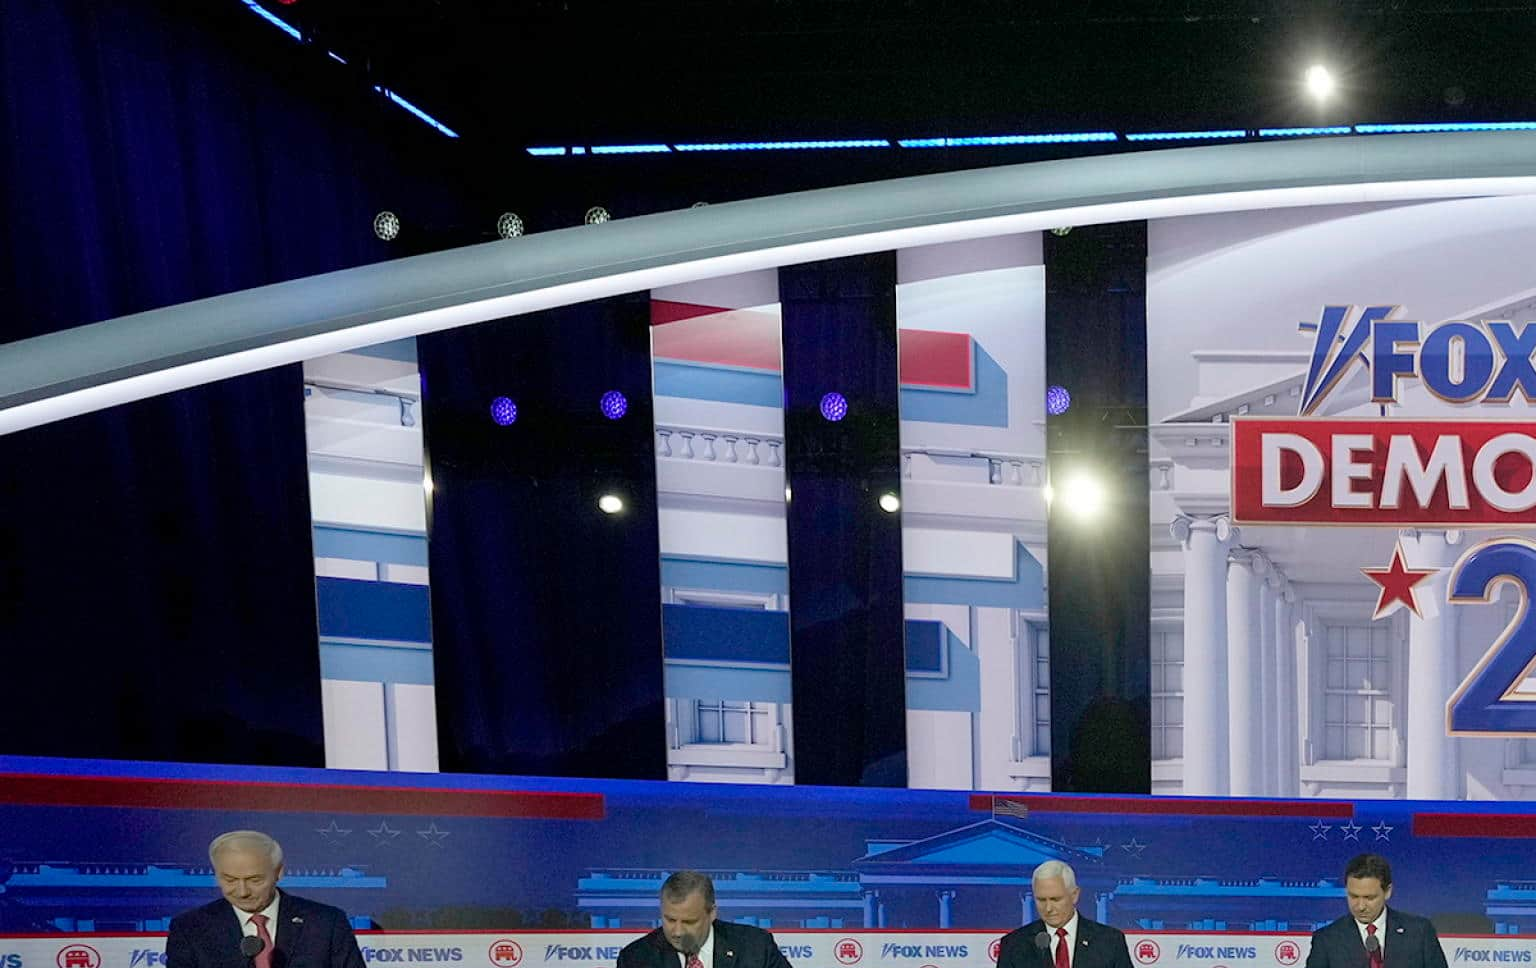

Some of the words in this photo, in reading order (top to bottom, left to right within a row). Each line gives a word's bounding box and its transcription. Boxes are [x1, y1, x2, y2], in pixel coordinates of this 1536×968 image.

[365, 947, 404, 962] FOX
[408, 948, 462, 962] NEWS
[558, 947, 592, 960] FOX
[893, 945, 921, 957] FOX
[926, 945, 968, 957] NEWS
[1188, 947, 1214, 958] FOX
[1217, 947, 1256, 958] NEWS
[1464, 950, 1490, 961] FOX
[1493, 950, 1531, 962] NEWS
